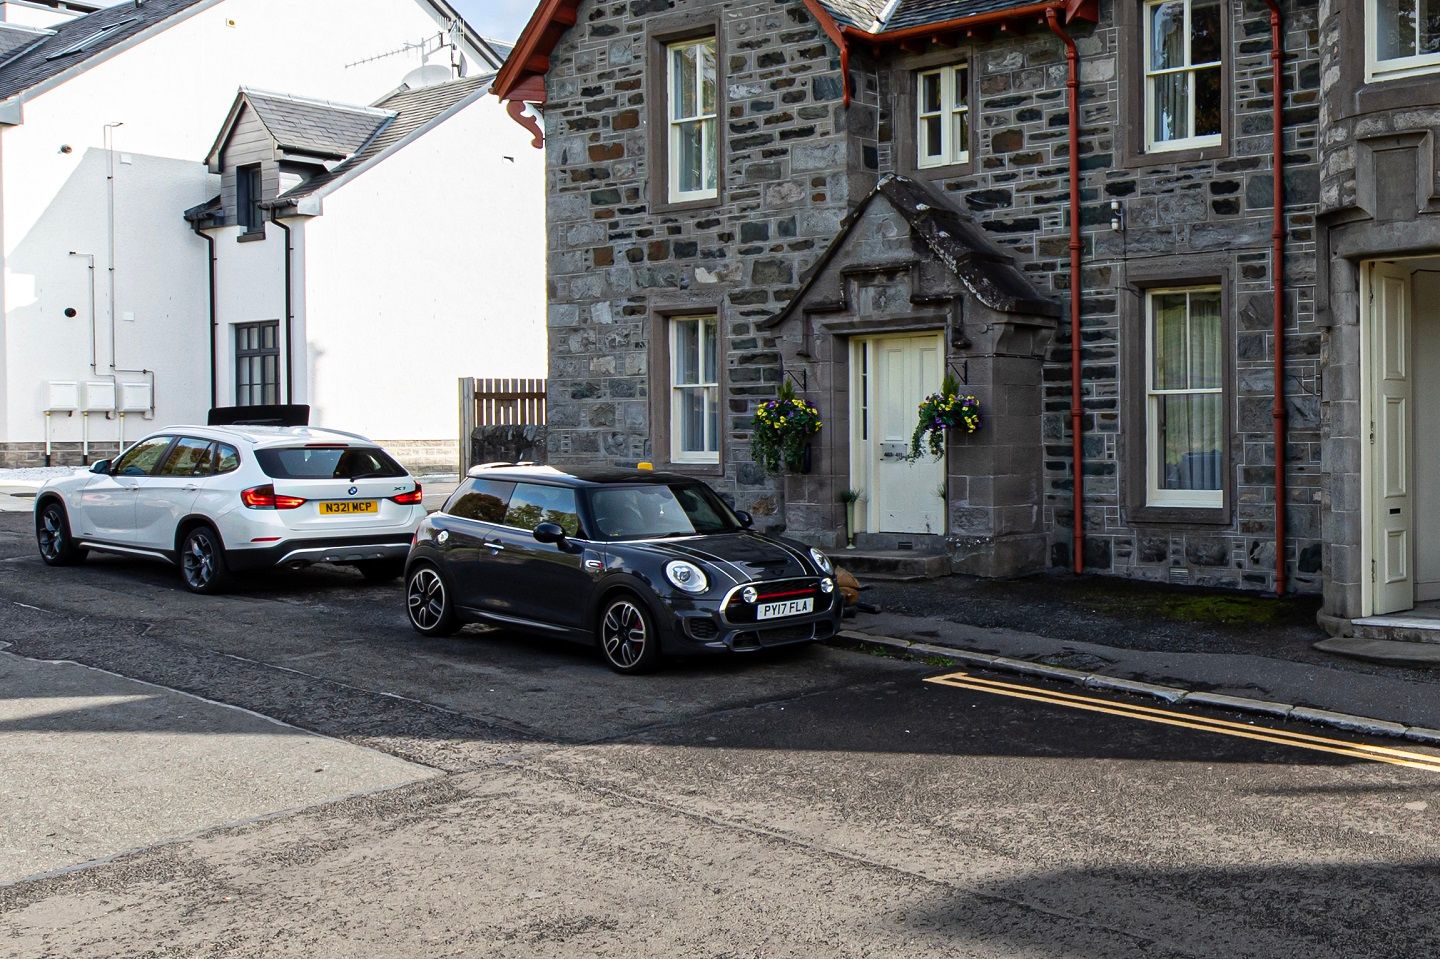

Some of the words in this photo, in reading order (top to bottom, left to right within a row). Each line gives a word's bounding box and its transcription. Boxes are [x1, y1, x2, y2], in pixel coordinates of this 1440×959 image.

[326, 503, 349, 512] N321
[352, 502, 372, 512] MCP
[763, 603, 787, 616] PY17
[789, 600, 808, 613] FLA
